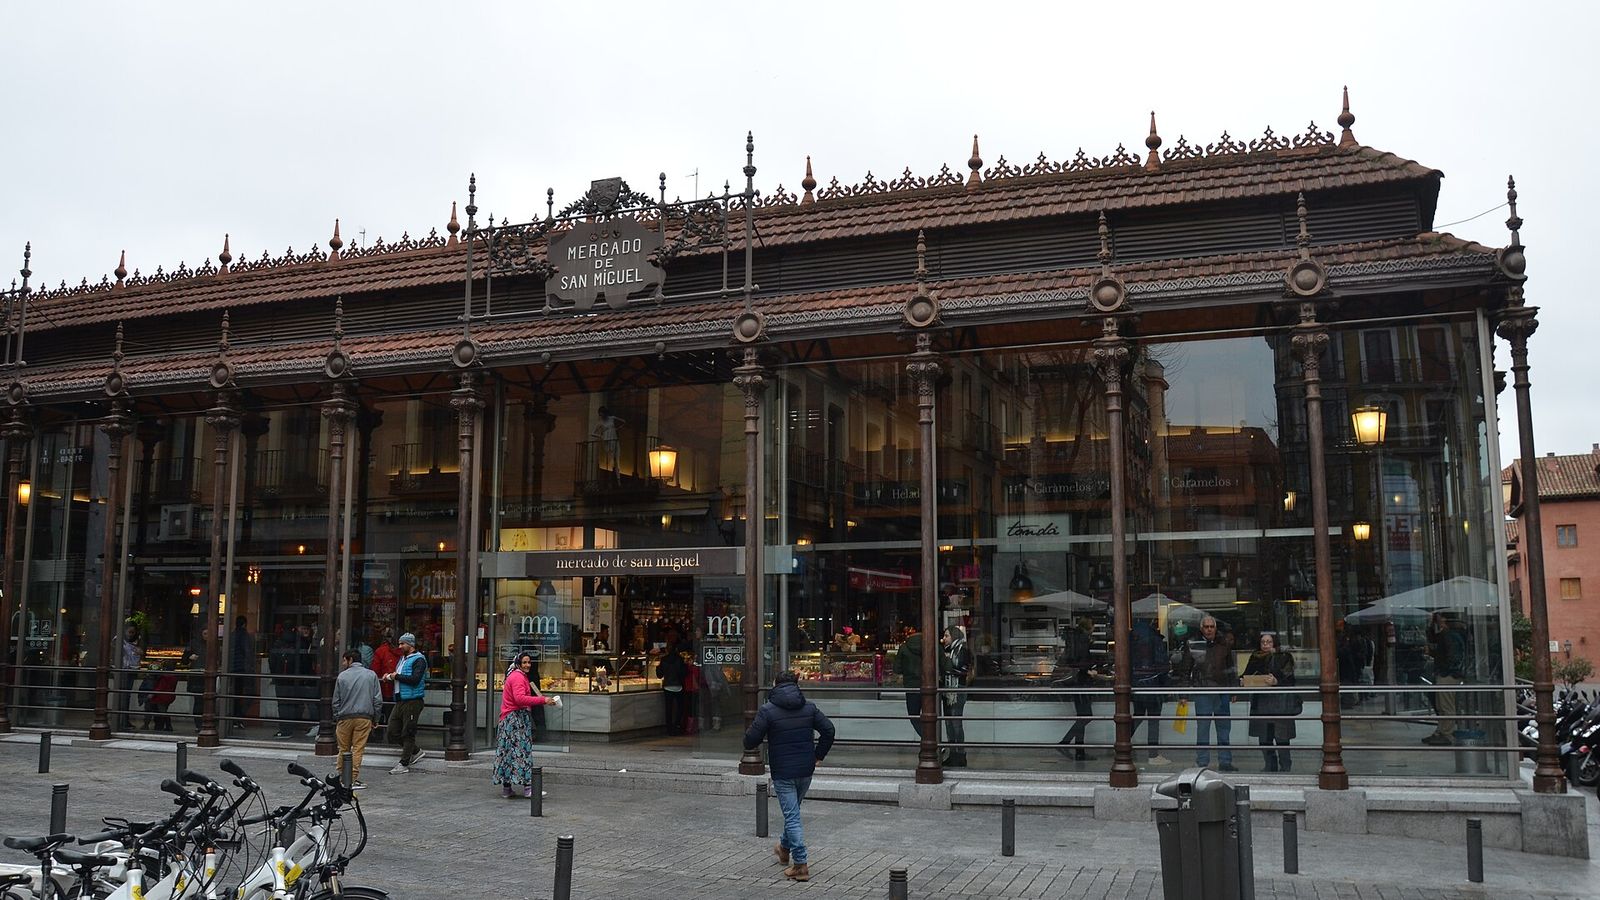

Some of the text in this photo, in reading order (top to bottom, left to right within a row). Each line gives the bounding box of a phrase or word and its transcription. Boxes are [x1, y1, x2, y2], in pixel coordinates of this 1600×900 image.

[567, 238, 642, 261] MERCADO
[594, 258, 614, 269] DE
[560, 268, 644, 290] SAN MIGUEL
[1034, 481, 1092, 494] Caramelos
[1171, 475, 1232, 489] Caramelos
[892, 487, 920, 500] Helad
[556, 553, 700, 572] mercado de san miguel
